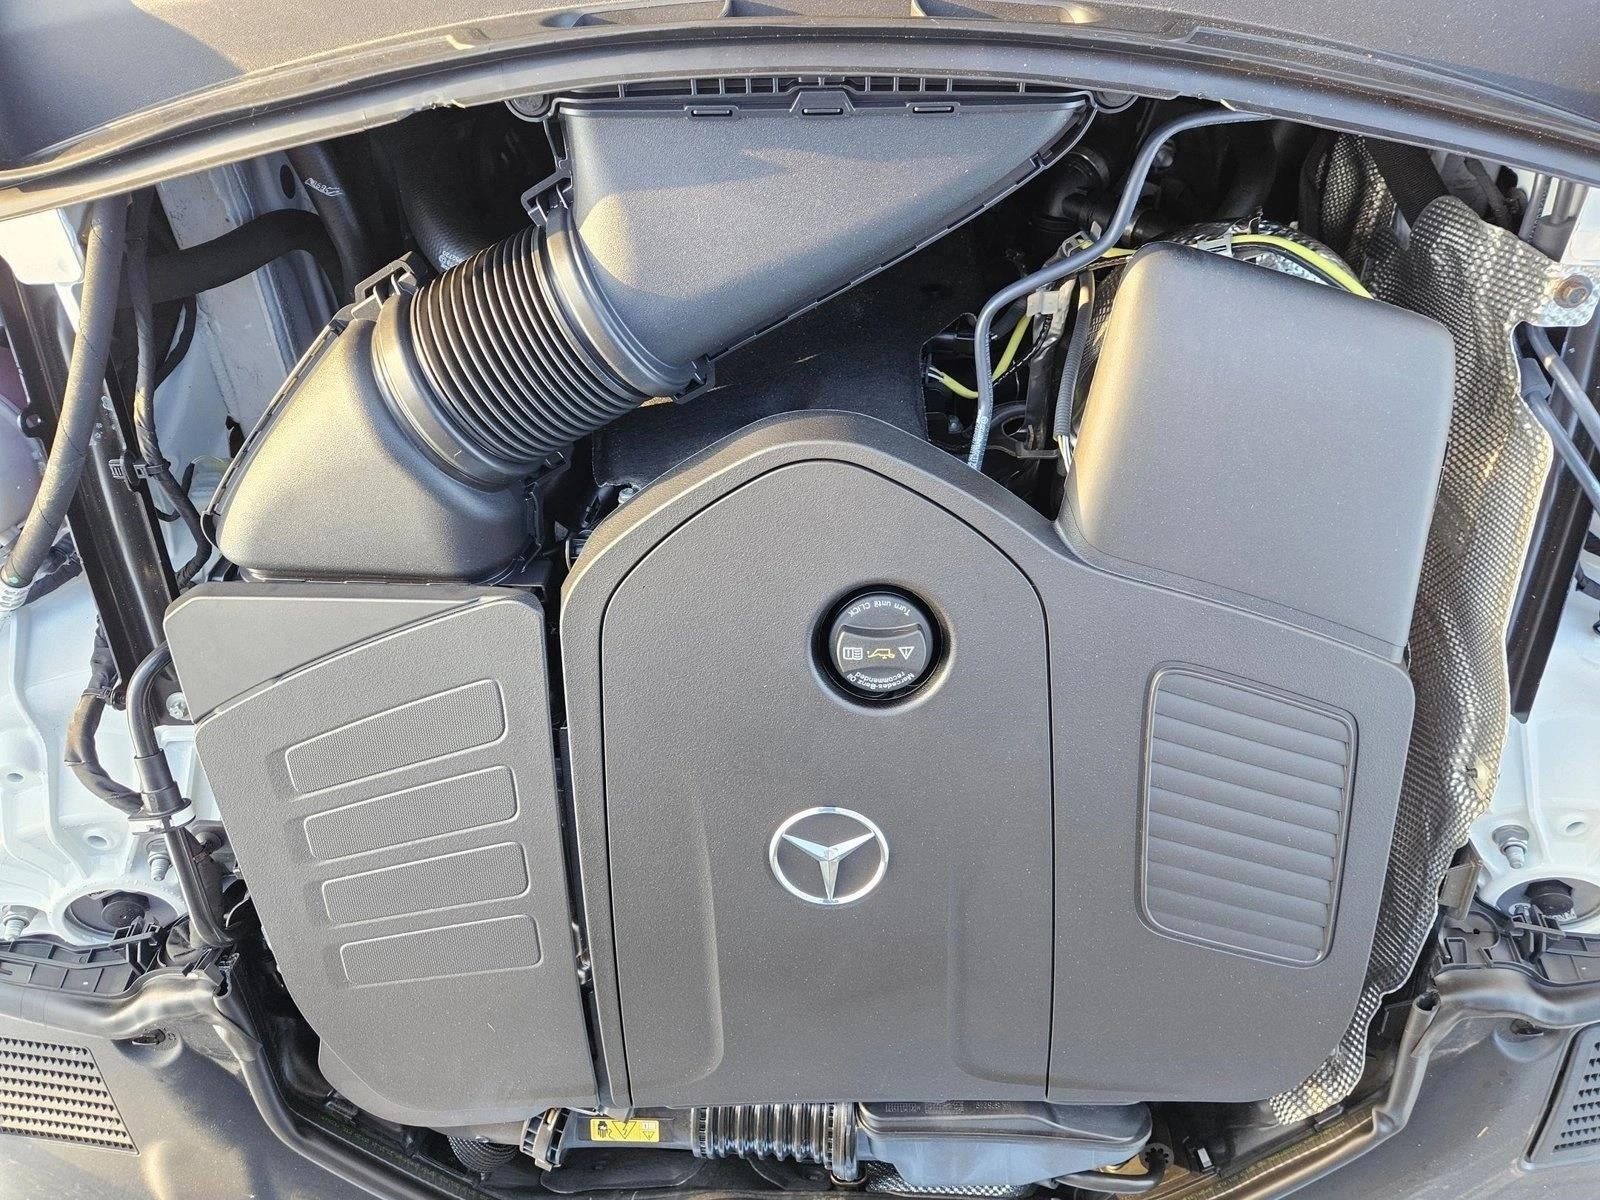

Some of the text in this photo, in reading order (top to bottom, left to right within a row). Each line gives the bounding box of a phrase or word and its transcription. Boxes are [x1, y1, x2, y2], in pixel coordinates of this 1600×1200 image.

[848, 602, 871, 617] CLICK
[894, 602, 911, 616] Turn
[856, 671, 905, 683] recommended
[857, 672, 915, 689] Mercedes-Benz
